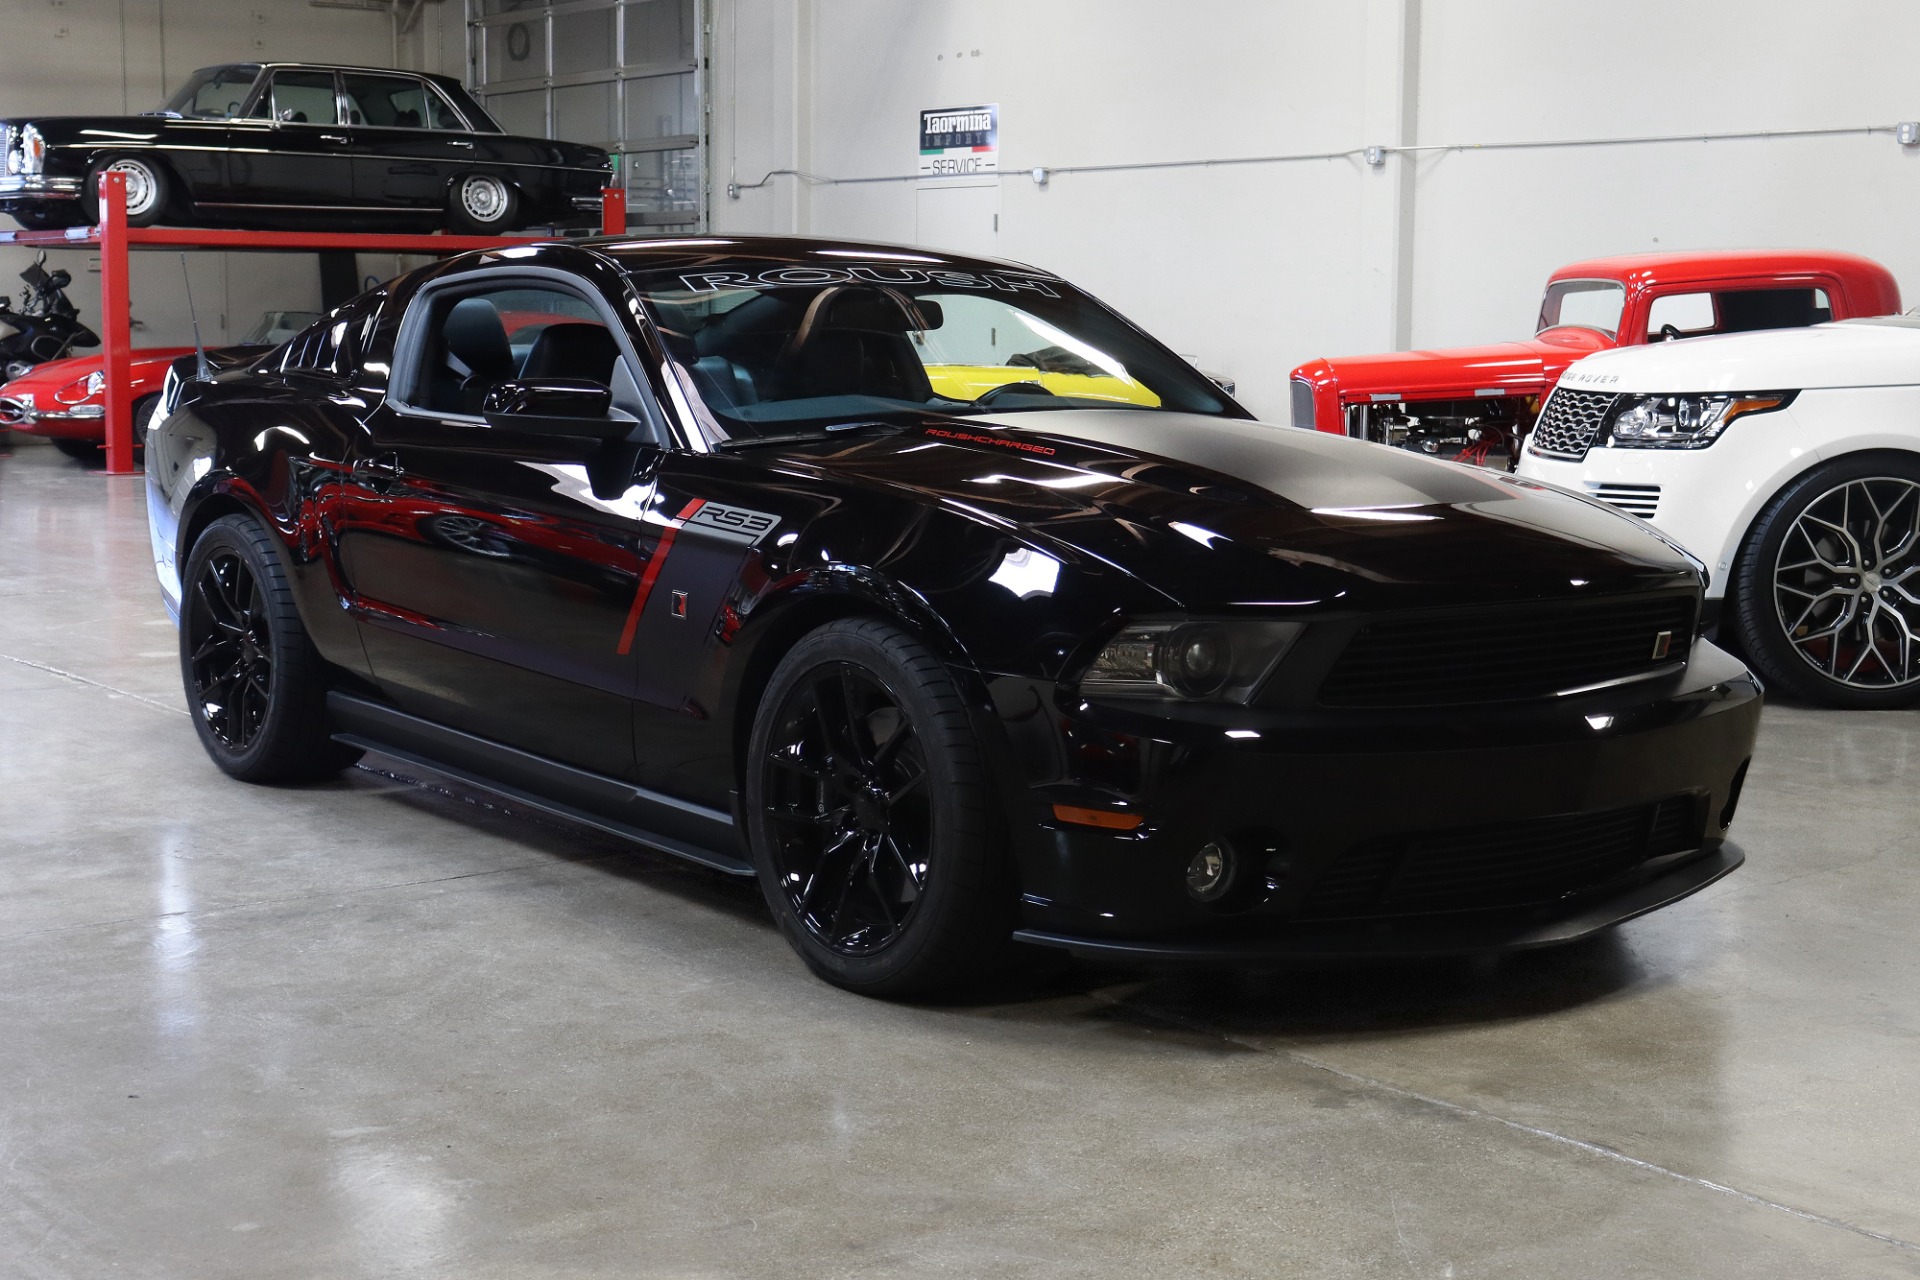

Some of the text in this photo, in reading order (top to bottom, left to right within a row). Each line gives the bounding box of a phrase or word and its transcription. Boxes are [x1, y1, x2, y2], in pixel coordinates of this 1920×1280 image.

[924, 109, 992, 134] Taormina
[932, 157, 982, 175] SERVICE
[679, 267, 1062, 298] ROUSH
[1578, 374, 1619, 384] ROVER
[925, 428, 1056, 456] ROUSHCHARGED
[697, 506, 773, 531] RS3
